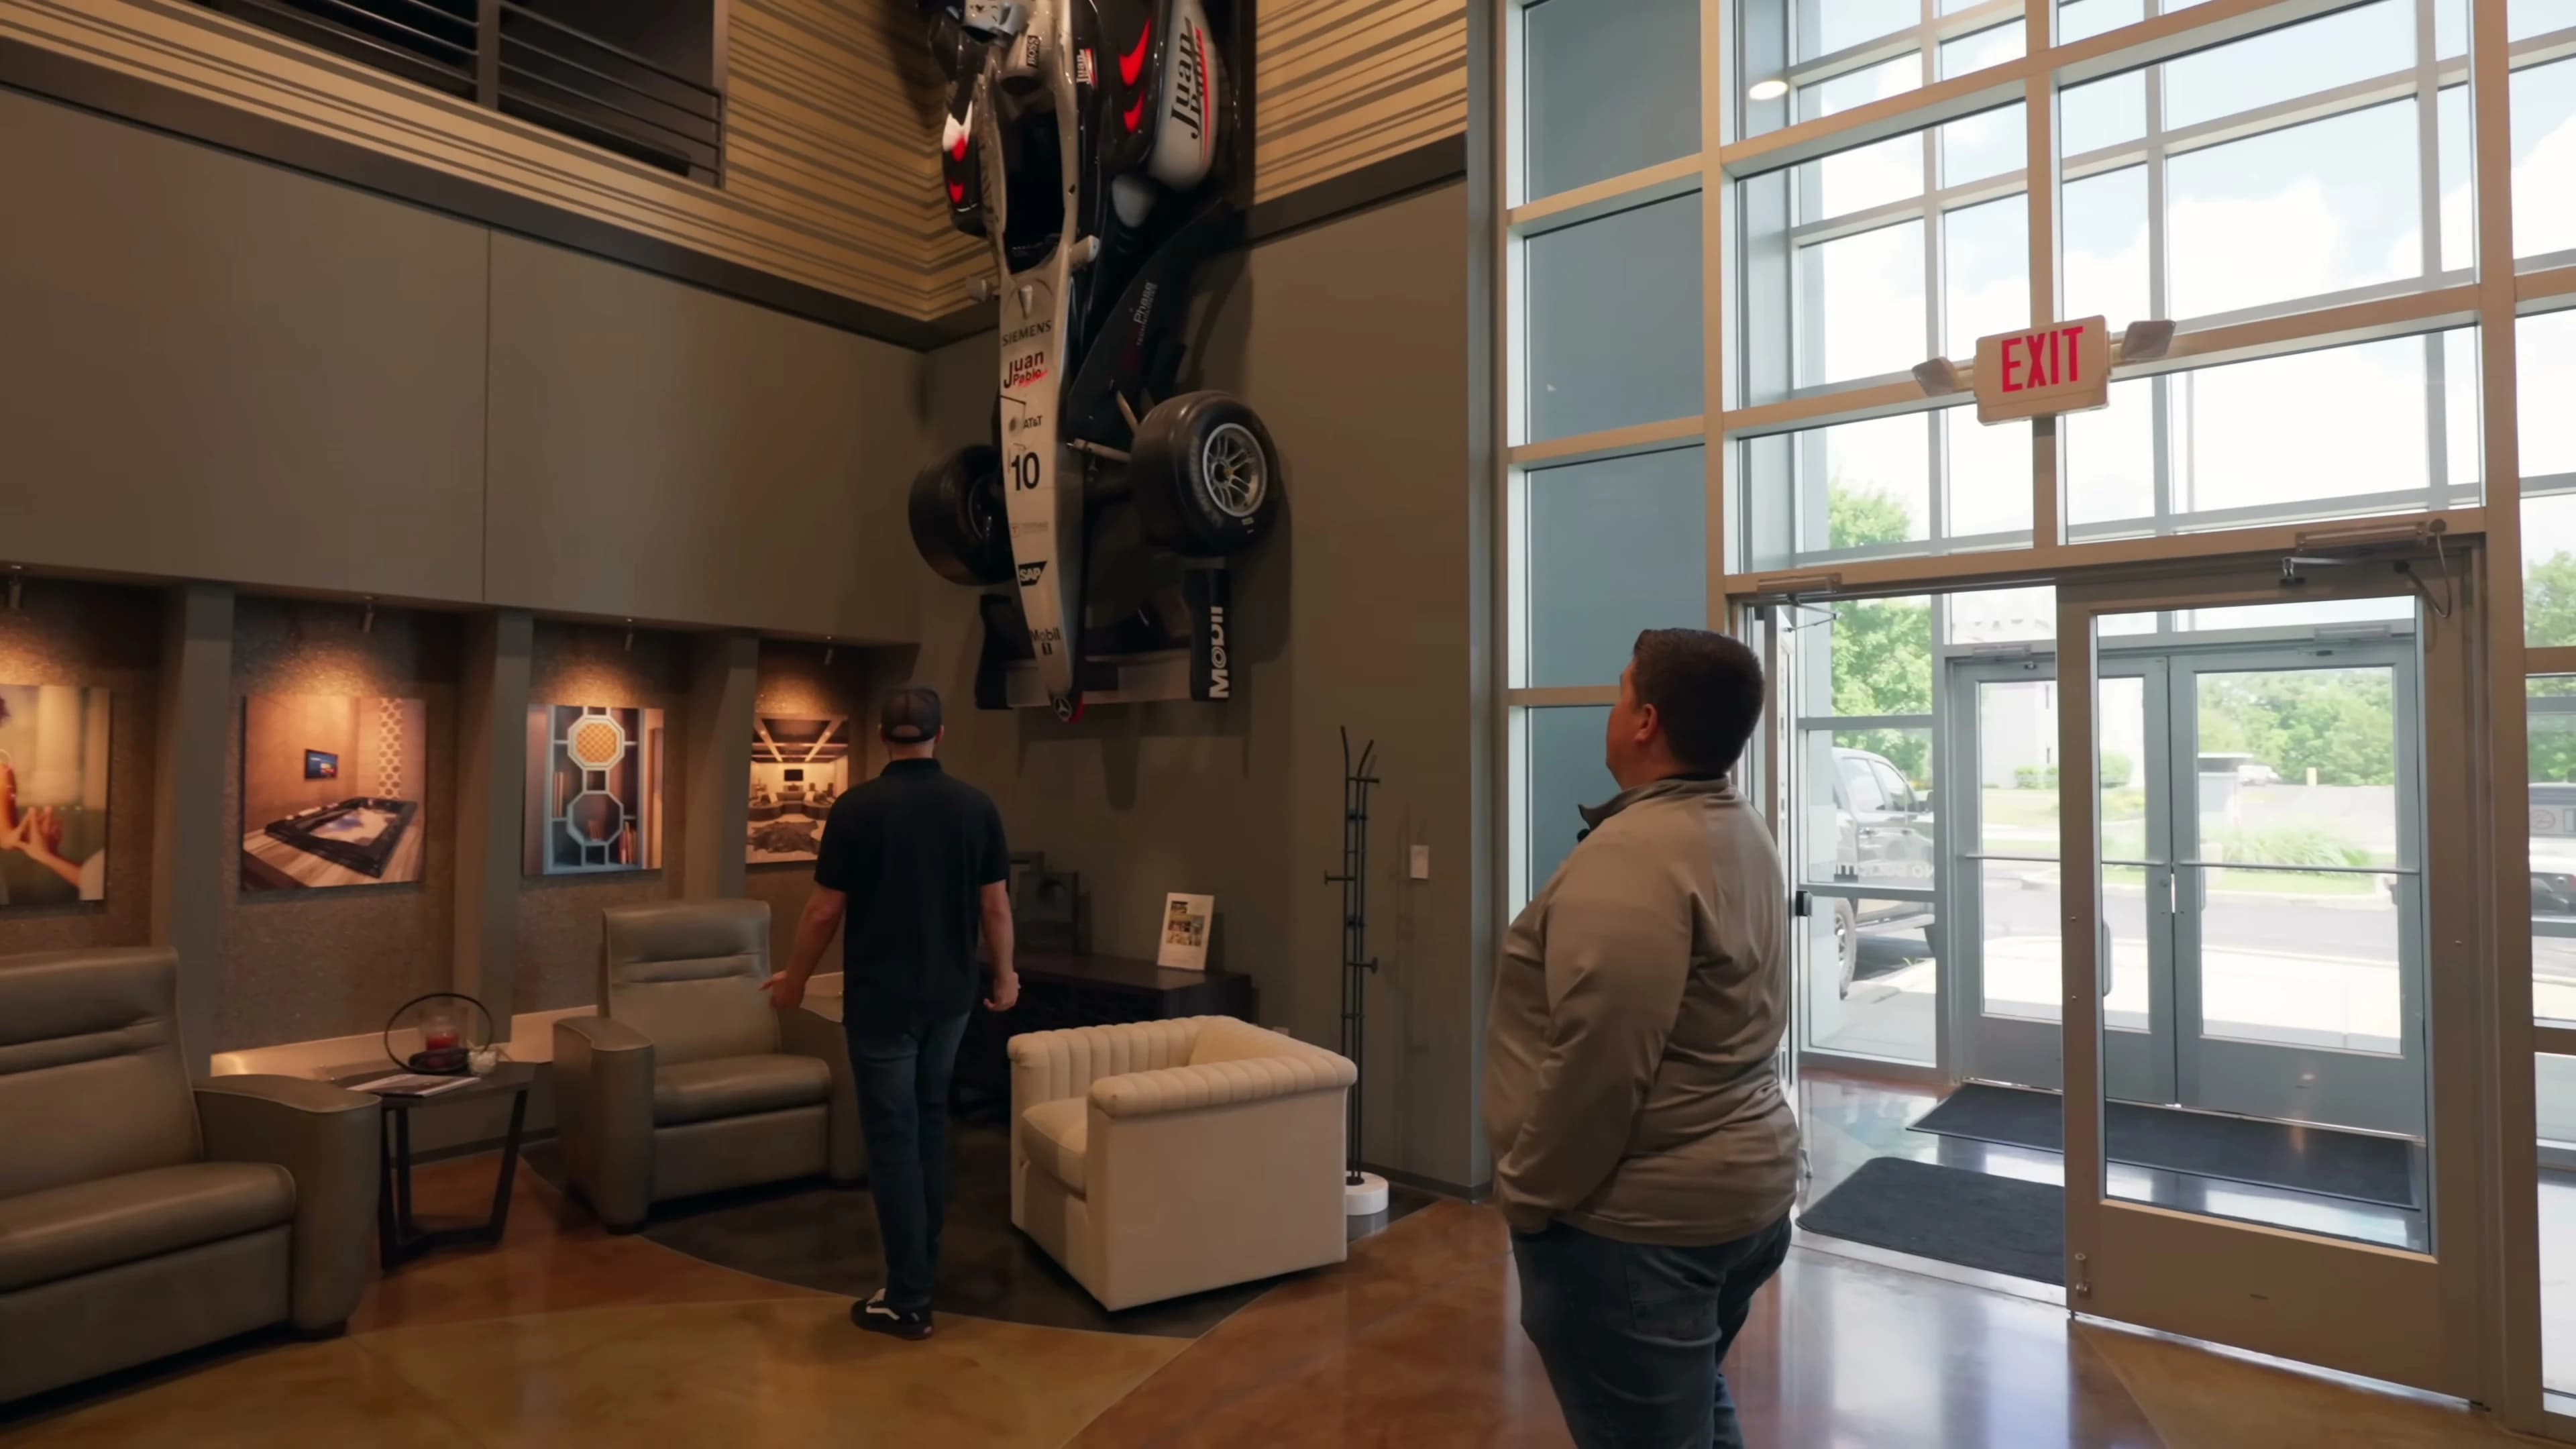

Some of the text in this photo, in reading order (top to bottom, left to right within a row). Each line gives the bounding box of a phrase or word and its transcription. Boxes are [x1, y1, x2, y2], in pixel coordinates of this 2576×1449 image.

[1027, 36, 1039, 66] BOSS
[1170, 33, 1199, 139] Juan
[1003, 320, 1051, 347] SIEMENS
[1004, 351, 1044, 388] Juan
[2002, 326, 2085, 392] EXIT
[1014, 369, 1042, 386] Pablo
[1024, 415, 1042, 429] AT&T
[1011, 451, 1040, 491] 10
[1020, 568, 1041, 582] SAP
[1209, 606, 1229, 698] Mobil
